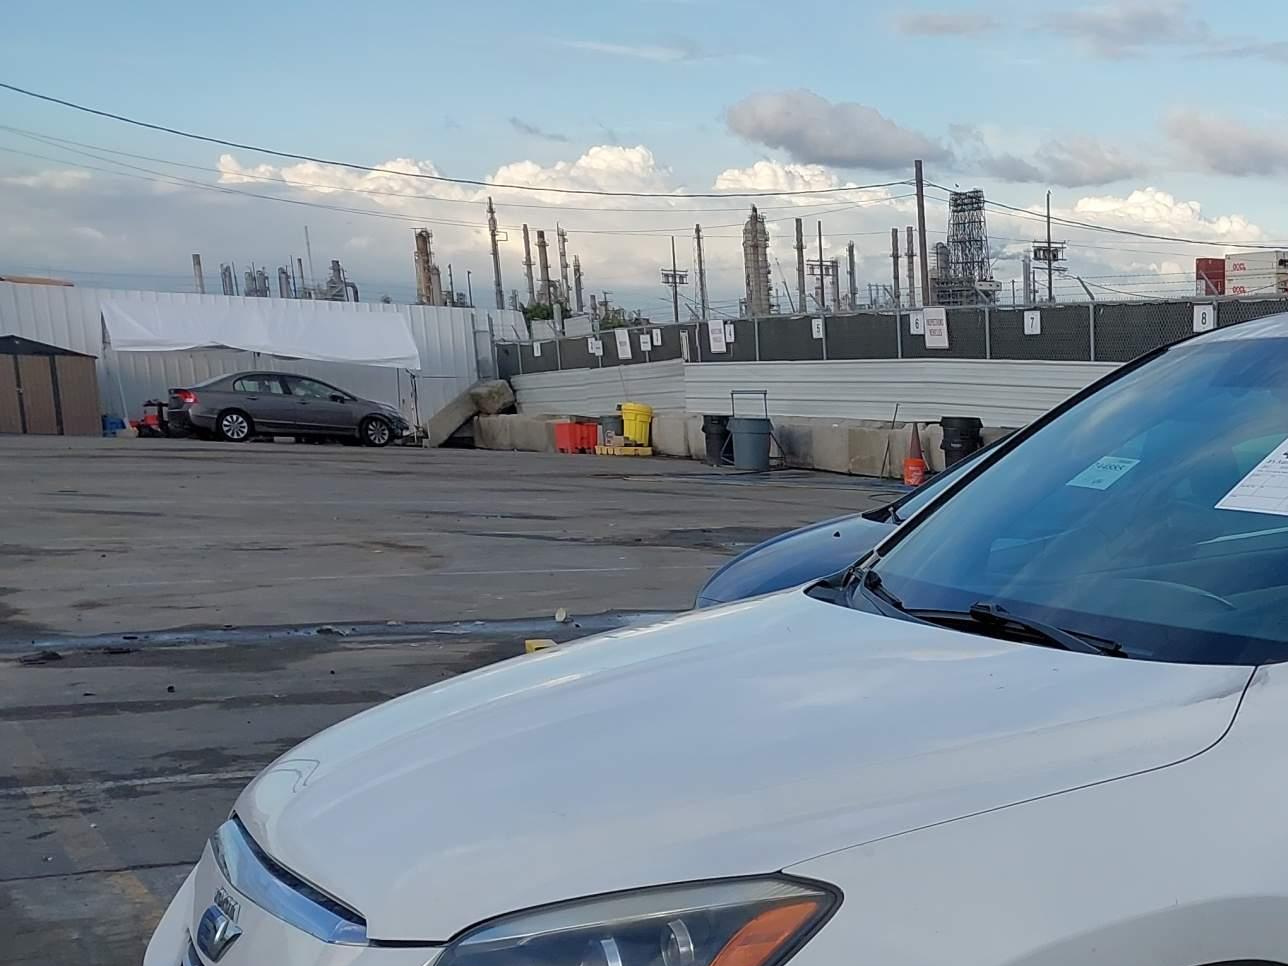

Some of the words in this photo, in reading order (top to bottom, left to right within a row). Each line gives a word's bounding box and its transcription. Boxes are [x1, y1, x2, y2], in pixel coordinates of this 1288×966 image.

[914, 318, 920, 330] 6
[1030, 316, 1035, 329] 7
[1201, 311, 1207, 326] 8
[815, 323, 821, 334] 5
